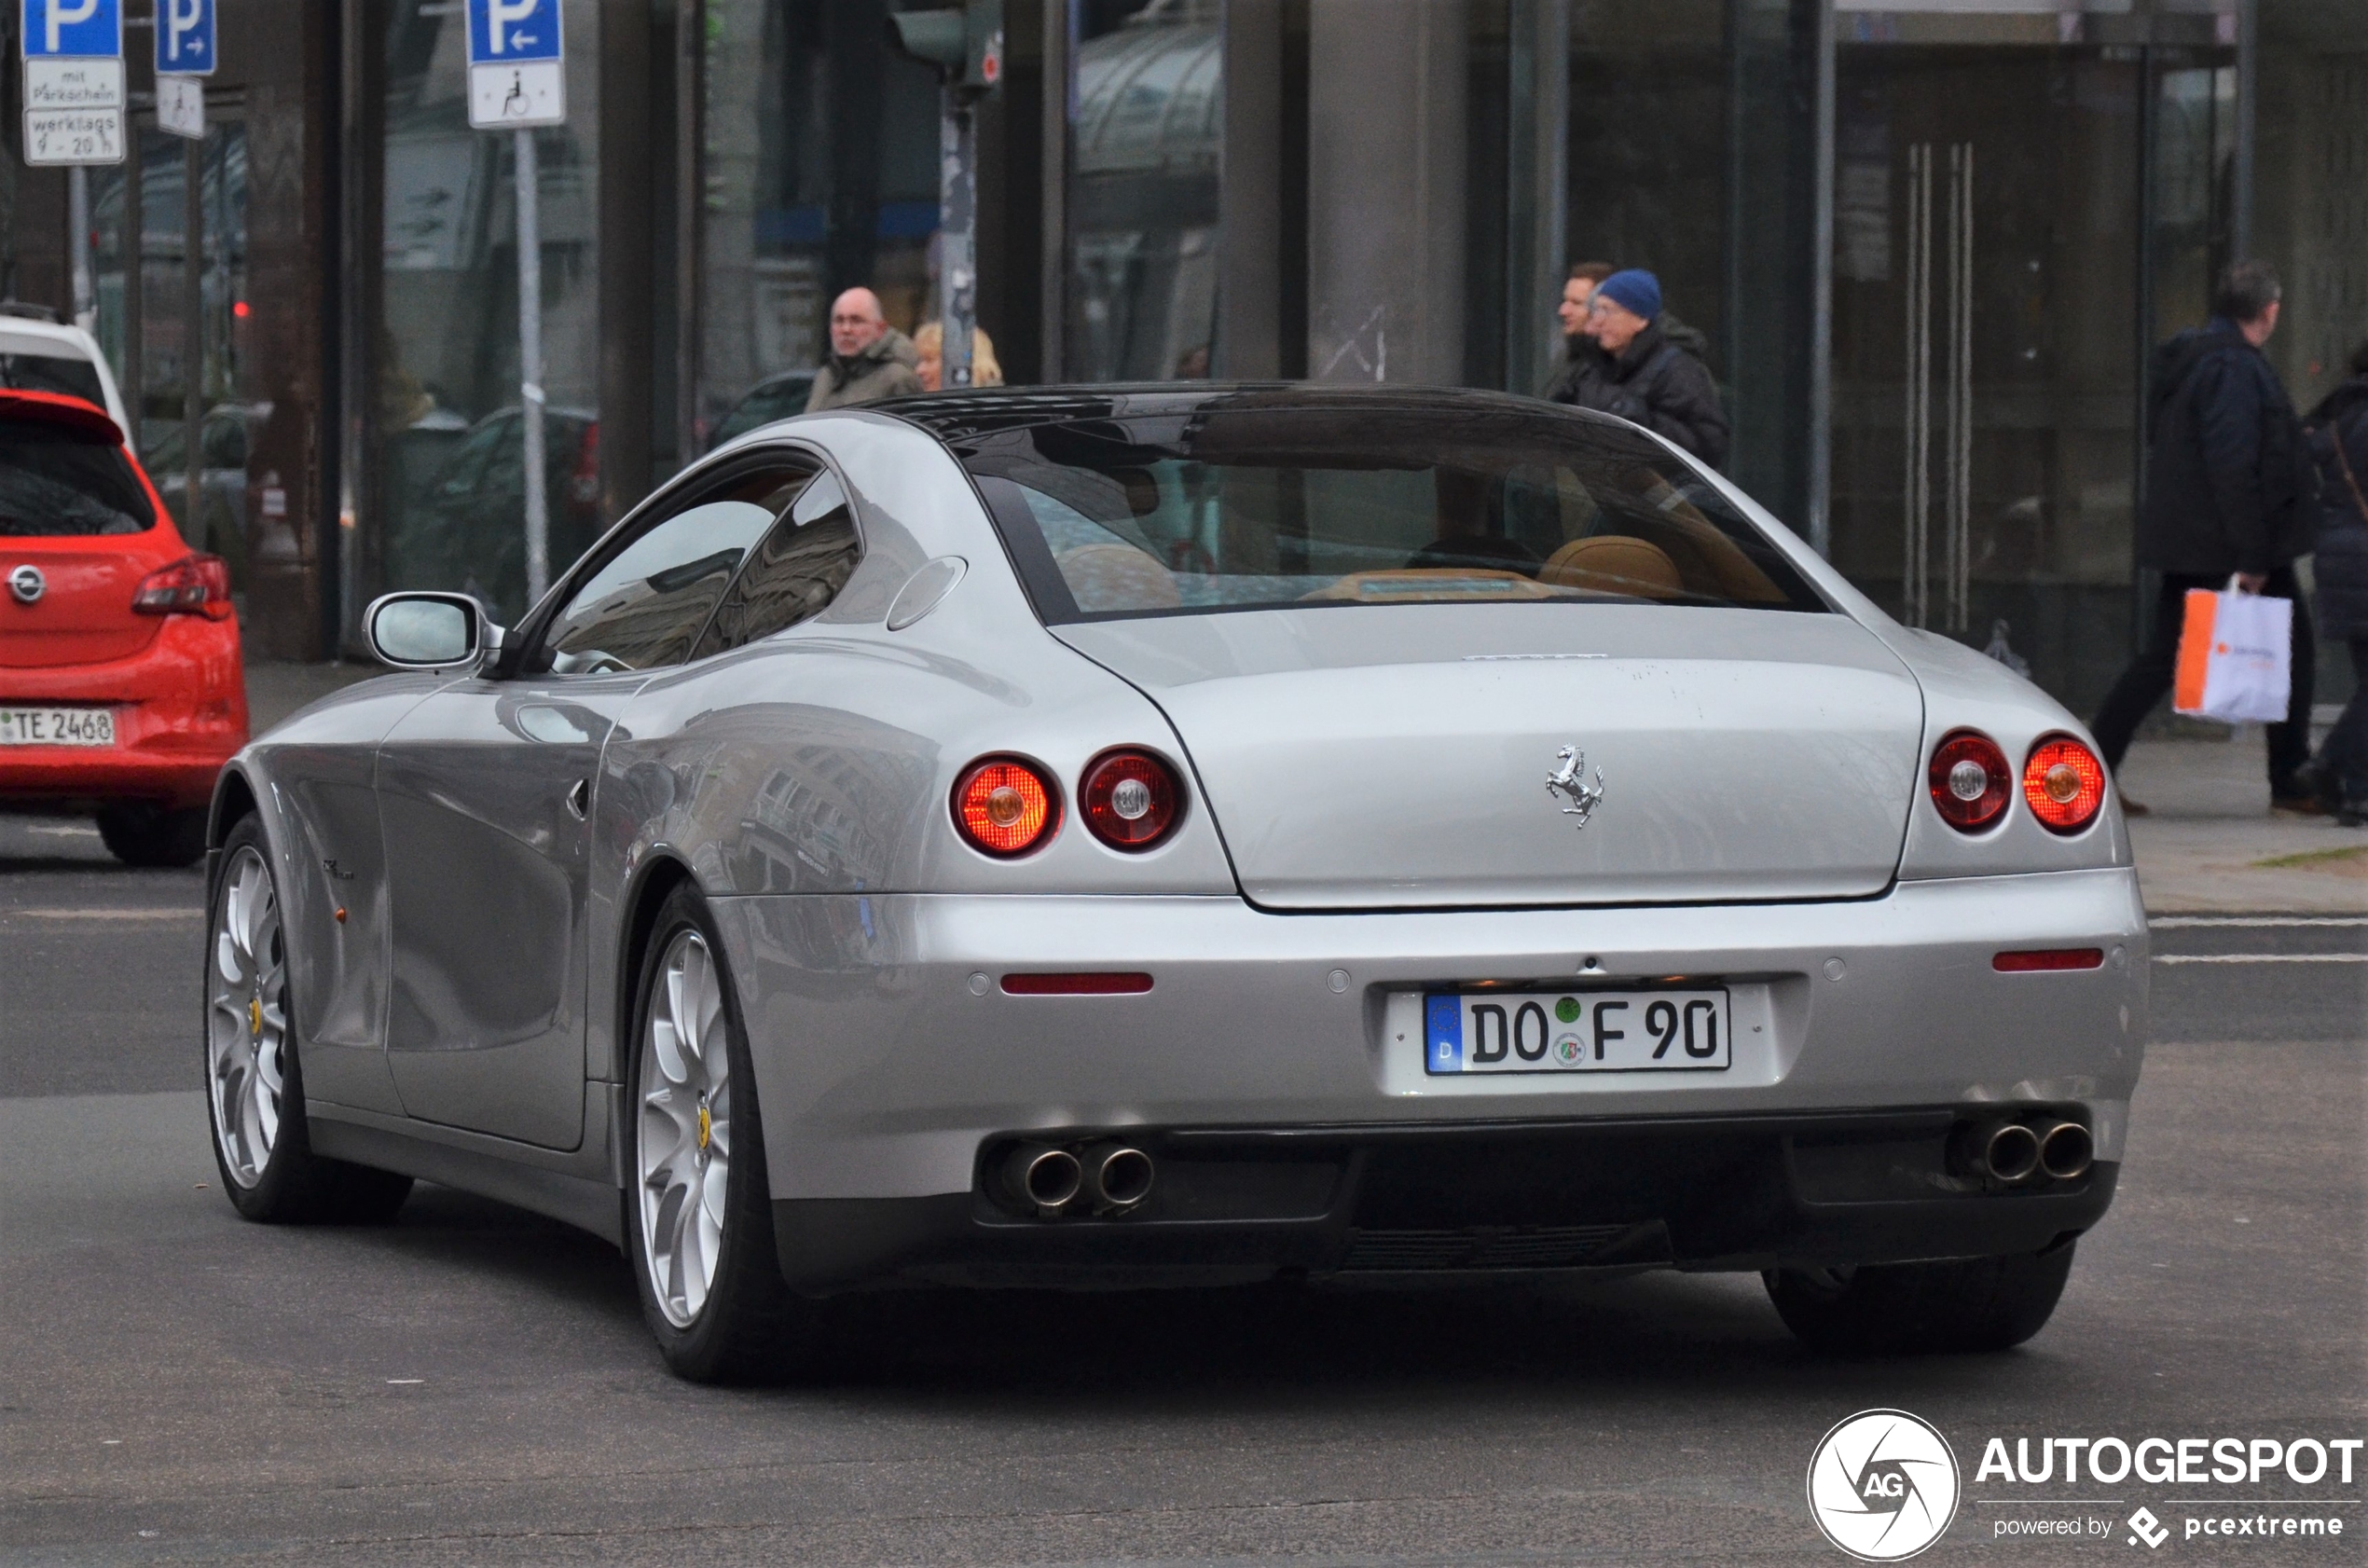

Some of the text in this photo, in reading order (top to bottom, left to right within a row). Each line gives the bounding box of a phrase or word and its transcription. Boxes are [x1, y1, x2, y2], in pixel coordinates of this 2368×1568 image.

[46, 0, 98, 52] P
[168, 0, 201, 61] P
[489, 0, 538, 54] P
[62, 72, 85, 83] mit
[34, 86, 114, 102] Parkschein
[33, 117, 115, 133] werktags
[38, 138, 47, 155] 9
[73, 136, 92, 155] 20
[15, 712, 111, 739] TE 2468
[1470, 1001, 1549, 1063] DO
[1593, 1001, 1629, 1060] F
[1645, 999, 1716, 1059] 90
[1440, 1042, 1452, 1058] D
